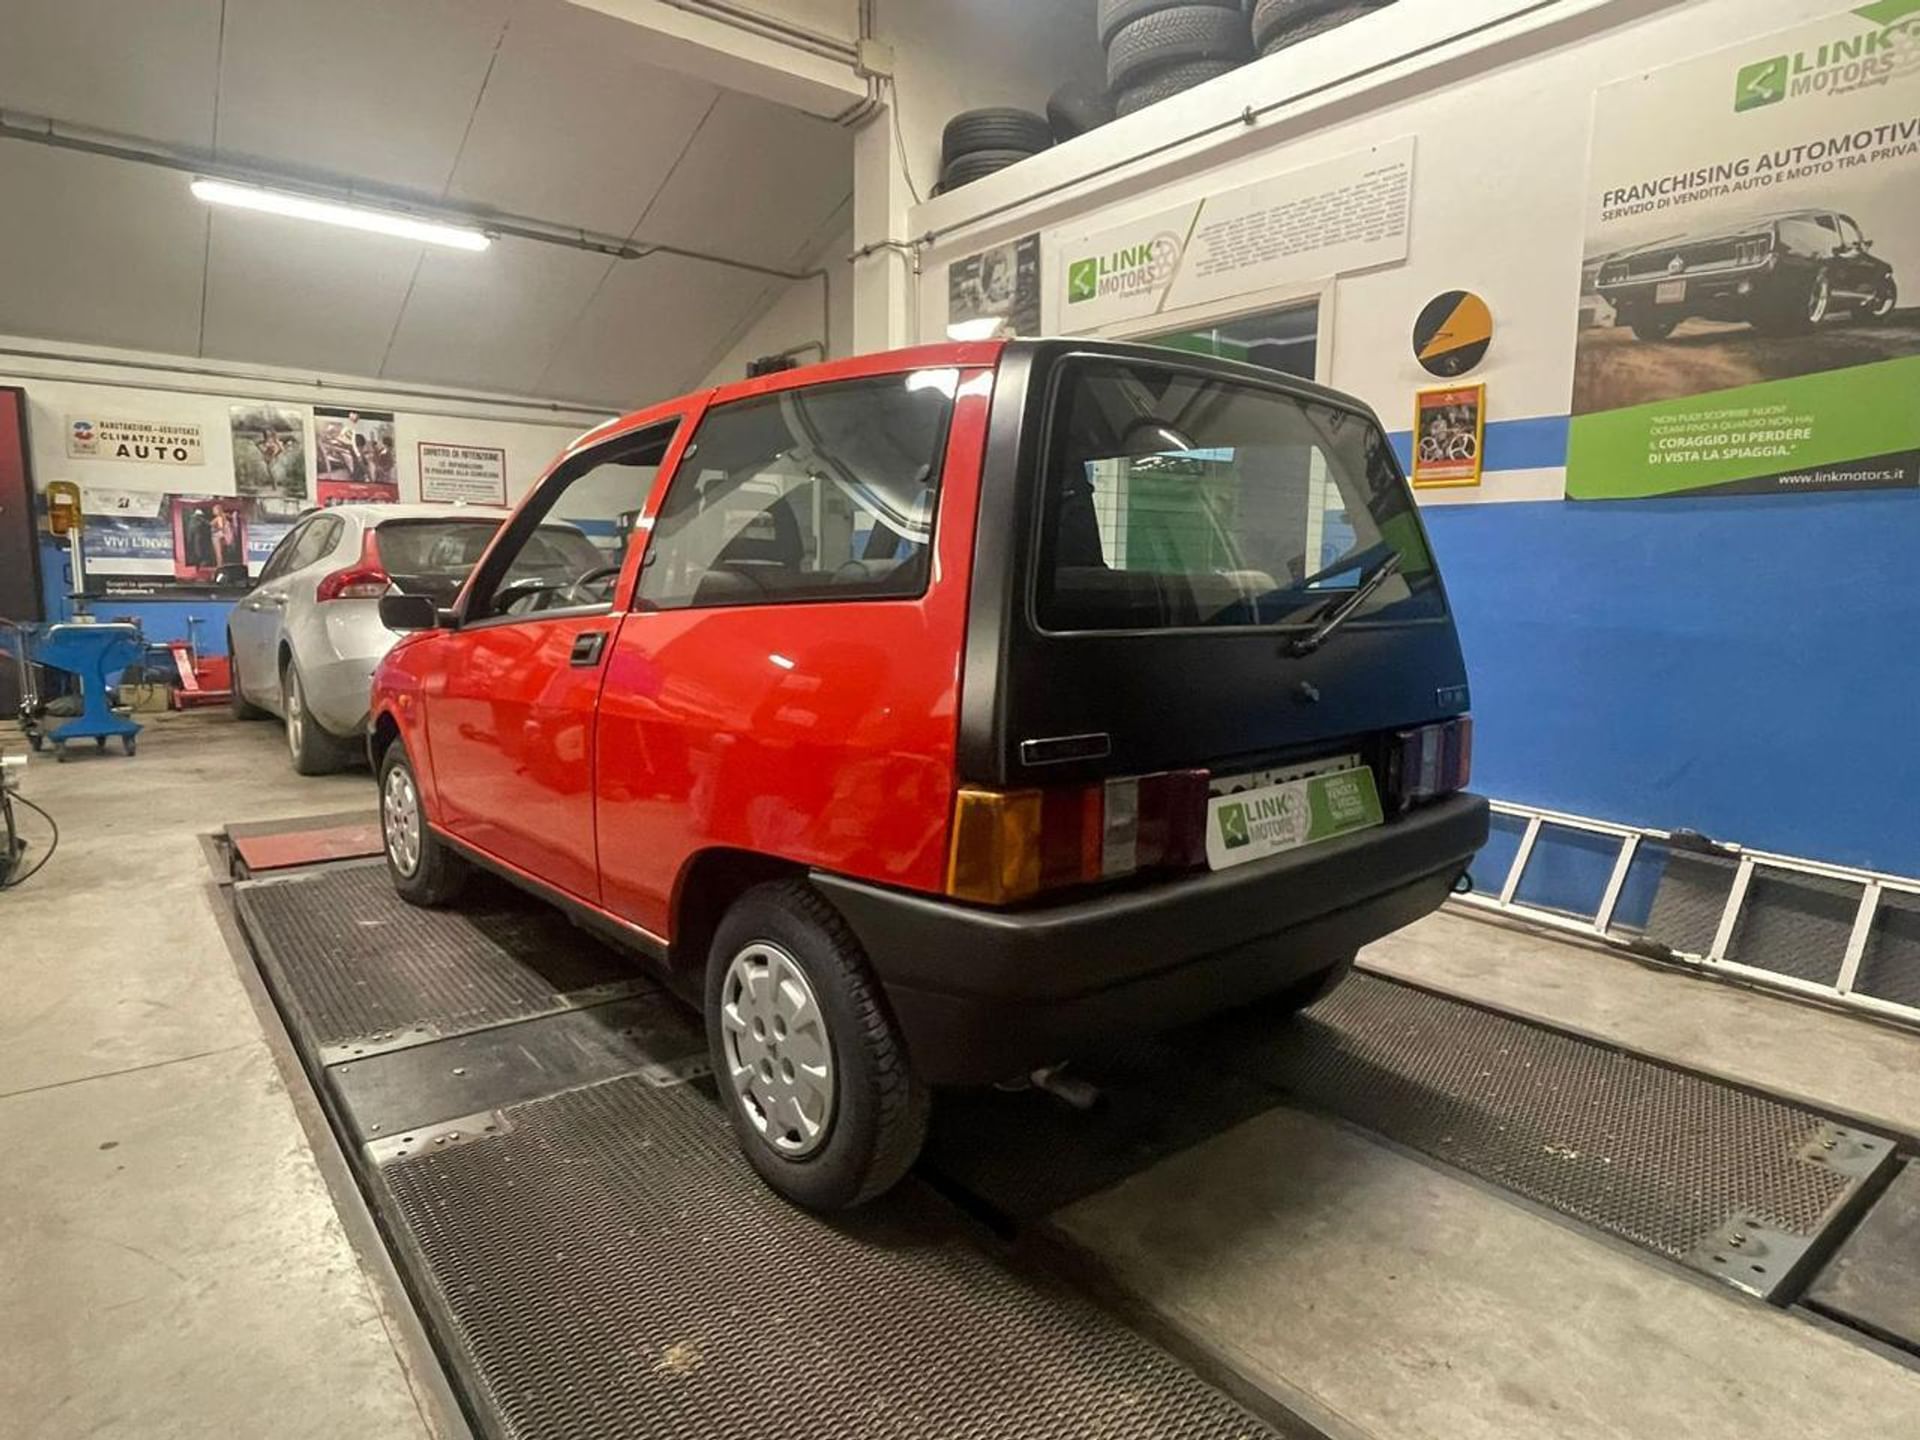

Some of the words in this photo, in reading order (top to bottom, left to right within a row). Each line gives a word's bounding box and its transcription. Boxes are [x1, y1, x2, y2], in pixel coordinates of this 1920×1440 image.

[1793, 28, 1895, 75] LINK
[1790, 51, 1895, 98] MOTORS
[1603, 158, 1750, 208] FRANCHISING
[1755, 117, 1920, 173] AUTOMOTIV
[1601, 200, 1654, 222] SERVIZIO
[1657, 196, 1670, 210] DI
[1673, 184, 1730, 205] VENDITA
[1732, 174, 1772, 193] AUTO
[1775, 170, 1785, 184] E
[1786, 160, 1834, 181] MOTO
[1836, 152, 1868, 170] TRA
[1871, 140, 1920, 163] PRIVA
[1100, 241, 1153, 275] LINK
[1099, 265, 1156, 297] MOTORS
[100, 431, 200, 447] CLIMATIZZATORI
[116, 443, 188, 461] AUTO
[1658, 433, 1729, 450] CORAGGIO
[1731, 432, 1746, 445] DI
[1748, 427, 1812, 443] PERDERE
[1648, 453, 1662, 465] DI
[1664, 450, 1700, 464] VISTA
[1702, 448, 1719, 461] LA
[1779, 467, 1905, 484] www.linkmotors.it
[1245, 793, 1290, 822] LINK
